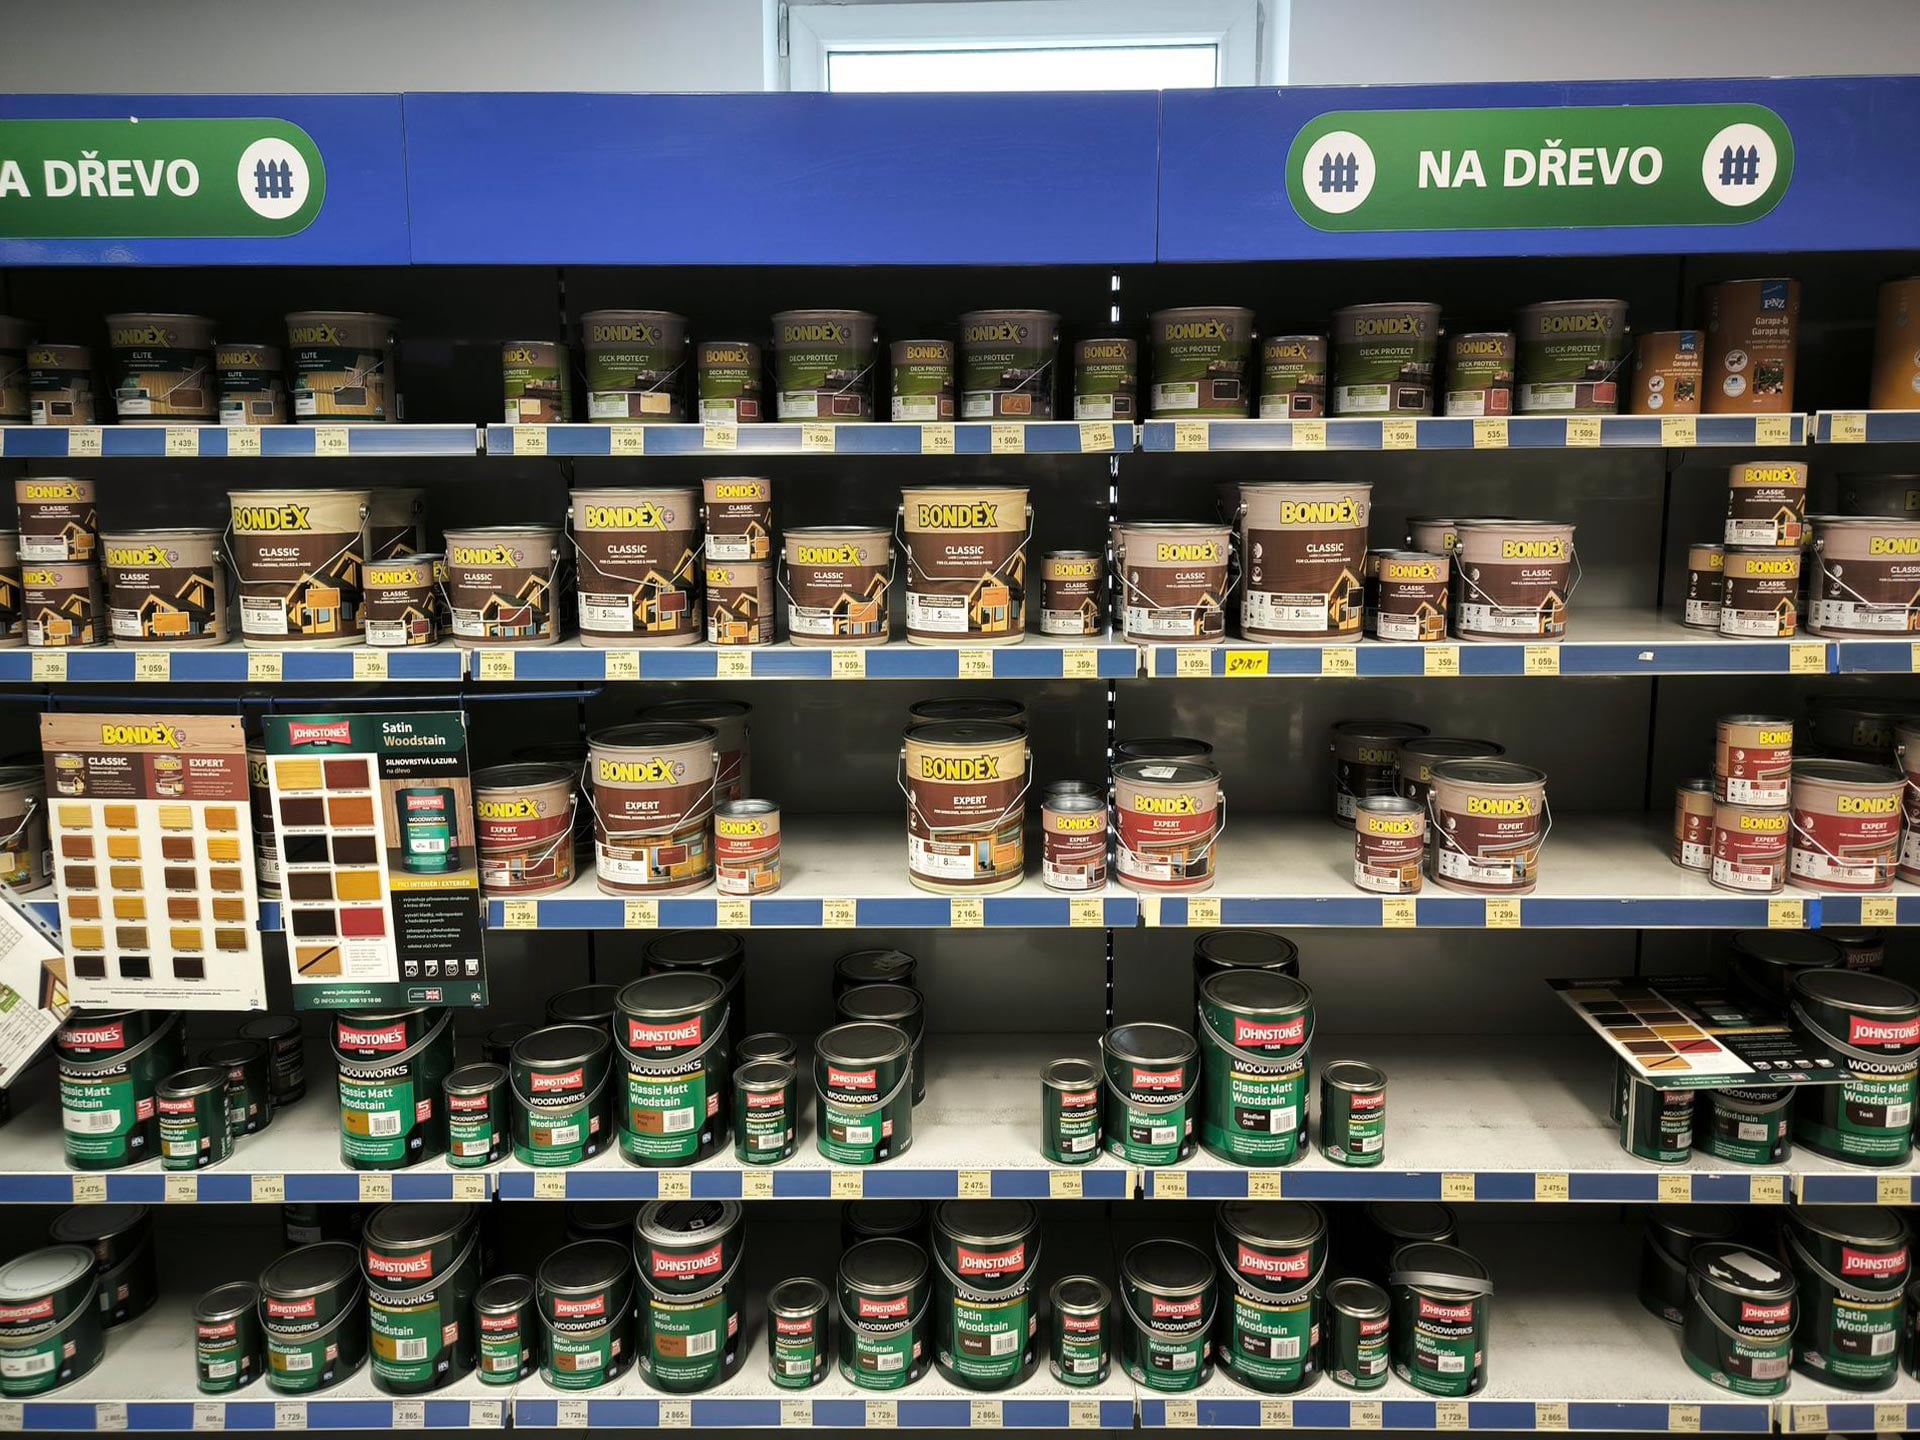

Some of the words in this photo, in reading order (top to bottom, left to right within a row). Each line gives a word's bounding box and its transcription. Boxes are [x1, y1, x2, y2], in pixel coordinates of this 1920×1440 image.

[1418, 150, 1488, 189] NA
[1503, 138, 1663, 187] DŘEVO
[0, 160, 31, 198] A
[43, 150, 200, 198] DŘEVO
[1764, 297, 1786, 310] PNZ
[1355, 314, 1422, 338] BONDEX
[1540, 311, 1607, 334] BONDEX
[593, 322, 656, 345] BONDEX
[784, 321, 847, 345] BONDEX
[1165, 319, 1228, 342] BONDEX
[1751, 327, 1777, 337] Garapa
[132, 351, 153, 360] ELITE
[1360, 348, 1378, 356] DECK
[1380, 347, 1414, 356] PROTECT
[1545, 346, 1564, 354] DECK
[1567, 345, 1601, 353] PROTECT
[599, 355, 615, 363] DECK
[616, 355, 649, 363] PROTECT
[81, 439, 95, 448] 515
[240, 439, 254, 448] 515
[934, 437, 949, 445] 535
[1305, 433, 1319, 441] 535
[234, 504, 311, 530] BONDEX
[585, 502, 667, 531] BONDEX
[918, 500, 998, 528] BONDEX
[1280, 497, 1361, 526] BONDEX
[259, 548, 300, 557] CLASSIC
[607, 545, 647, 554] CLASSIC
[945, 546, 984, 555] CLASSIC
[1157, 540, 1219, 562] BONDEX
[1306, 543, 1344, 553] CLASSIC
[1502, 537, 1566, 560] BONDEX
[107, 545, 172, 568] BONDEX
[454, 544, 518, 568] BONDEX
[797, 543, 862, 567] BONDEX
[120, 573, 150, 581] CLASSIC
[463, 573, 492, 581] CLASSIC
[813, 571, 844, 580] CLASSIC
[1175, 572, 1206, 580] CLASSIC
[1521, 569, 1552, 577] CLASSIC
[367, 663, 381, 671] 359
[1076, 660, 1090, 668] 359
[1229, 658, 1264, 672] SPIRIT
[1438, 658, 1452, 666] 359
[293, 726, 347, 740] JOHNSTONE'S
[382, 721, 412, 733] Satin
[102, 721, 181, 749] BONDEX
[383, 734, 446, 747] Woodstain
[88, 757, 128, 766] CLASSIC
[189, 759, 224, 767] EXPERT
[385, 756, 430, 766] SILNOVRSTVÁ
[431, 757, 457, 766] LAZURA
[599, 757, 678, 784] BONDEX
[921, 755, 1000, 782] BONDEX
[625, 801, 659, 810] EXPERT
[953, 795, 988, 805] EXPERT
[1134, 794, 1197, 815] BONDEX
[1467, 796, 1532, 815] BONDEX
[490, 825, 517, 834] EXPERT
[720, 819, 764, 835] BONDEX
[1154, 820, 1180, 828] EXPERT
[1369, 819, 1416, 834] BONDEX
[1861, 822, 1887, 831] EXPERT
[1082, 910, 1097, 918] 465
[1395, 910, 1409, 918] 465
[340, 1028, 402, 1045] JOHNSTONE'S
[632, 1024, 697, 1042] JOHNSTONE'S
[1238, 1023, 1303, 1041] JOHNSTONE'S
[1848, 1058, 1919, 1073] WOODWORKS
[534, 1075, 580, 1088] JOHNSTONE'S
[830, 1072, 874, 1084] JOHNSTONE'S
[1136, 1072, 1182, 1085] JOHNSTONE'S
[340, 1083, 366, 1098] Classic
[368, 1088, 393, 1099] Matt
[630, 1082, 662, 1095] Classic
[663, 1084, 688, 1095] Matt
[1232, 1081, 1269, 1094] Classic
[1271, 1082, 1293, 1093] Matt
[1845, 1079, 1885, 1092] Classic
[1887, 1081, 1910, 1092] Matt
[530, 1093, 585, 1105] WOODWORKS
[630, 1094, 681, 1107] Woodstain
[827, 1091, 878, 1103] WOODWORKS
[1130, 1092, 1184, 1103] WOODWORKS
[1233, 1093, 1286, 1105] Woodstain
[1844, 1091, 1903, 1105] Woodstain
[341, 1098, 385, 1110] Woodstain
[747, 1109, 784, 1119] WOODWORKS
[826, 1115, 861, 1126] Woodstain
[1129, 1115, 1167, 1126] Woodstain
[1243, 1112, 1265, 1121] Medium
[1715, 1107, 1759, 1123] Woodstain
[369, 1257, 428, 1273] JOHNSTONE'S
[655, 1251, 719, 1272] JOHNSTONE'S
[961, 1251, 1022, 1269] JOHNSTONE'S
[1241, 1254, 1306, 1272] JOHNSTONE'S
[370, 1291, 434, 1305] WOODWORKS
[270, 1302, 313, 1314] JOHNSTONE'S
[558, 1301, 602, 1313] JOHNSTONE'S
[862, 1302, 906, 1313] JOHNSTONE'S
[1155, 1302, 1200, 1313] JOHNSTONE'S
[1236, 1304, 1261, 1321] Satin
[1421, 1304, 1470, 1317] JOHNSTONE'S
[654, 1311, 671, 1321] Satin
[957, 1308, 982, 1321] Satin
[1837, 1308, 1868, 1322] Satin
[268, 1321, 319, 1333] WOODWORKS
[553, 1318, 607, 1330] WOODWORKS
[654, 1320, 690, 1331] Woodstain
[858, 1320, 910, 1331] WOODWORKS
[957, 1319, 1009, 1333] Woodstain
[1150, 1319, 1202, 1332] WOODWORKS
[1236, 1317, 1288, 1335] Woodstain
[1417, 1320, 1473, 1335] WOODWORKS
[1836, 1318, 1892, 1332] Woodstain
[1416, 1334, 1436, 1347] Satin
[1150, 1342, 1187, 1353] Woodstain
[1416, 1342, 1456, 1357] Woodstain
[1735, 1347, 1777, 1358] Woodstain
